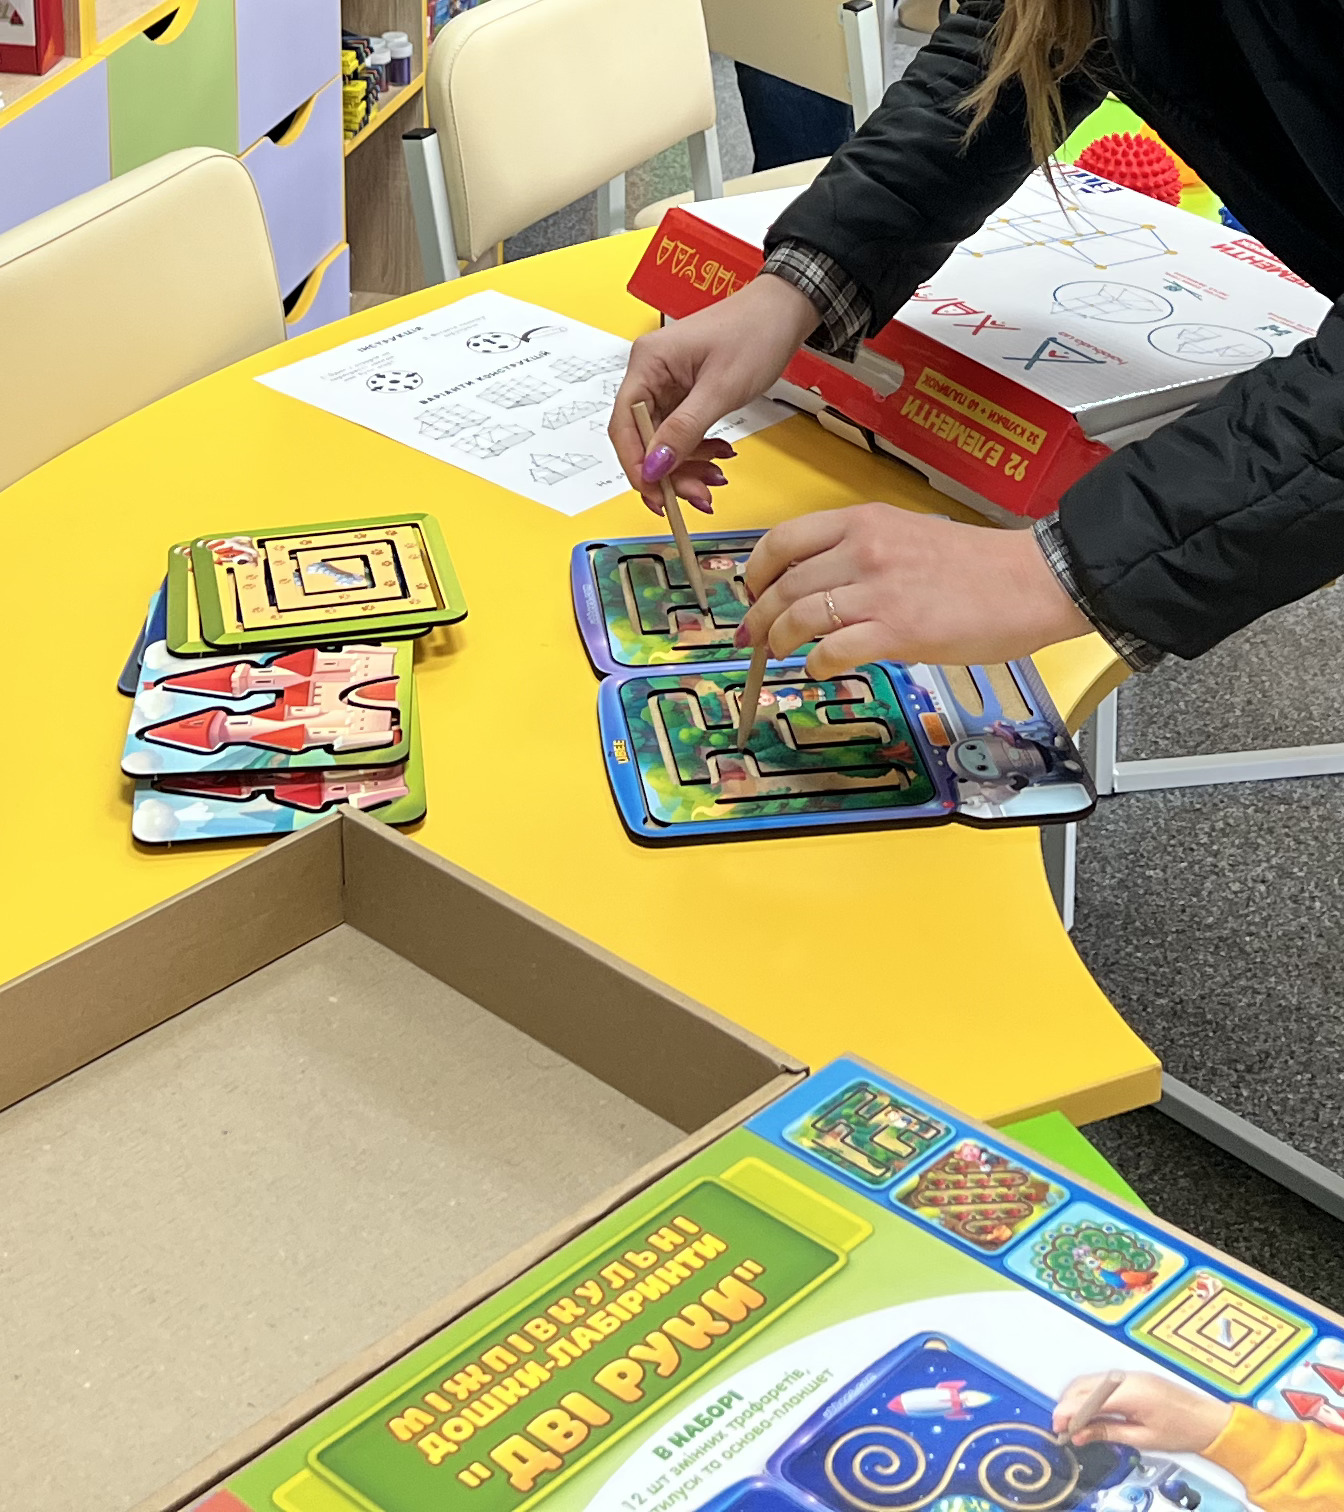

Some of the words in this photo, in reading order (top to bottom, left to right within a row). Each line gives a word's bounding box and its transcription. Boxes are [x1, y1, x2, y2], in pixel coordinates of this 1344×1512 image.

[419, 380, 474, 405] ВАРІАНТИ
[920, 374, 967, 408] ПАЛИЧОК
[967, 398, 980, 412] 60
[986, 408, 1027, 441] КУЛЬКИ
[899, 395, 1005, 467] ЕЛЕМЕНТИ
[1003, 452, 1030, 482] 92
[1026, 433, 1040, 447] 32
[387, 1216, 702, 1443] МІЖПІВКУЛЬНІ
[416, 1232, 729, 1466] ДОШКИ-ЛАБІРИНТИ
[456, 1390, 613, 1493] "ДВІ
[593, 1258, 767, 1404] РУКИ"
[652, 1441, 673, 1461] В
[667, 1389, 745, 1450] НАБОРІ
[672, 1429, 728, 1478] змінних
[725, 1367, 812, 1433] трафаретів,
[722, 1367, 835, 1462] основа-планшет
